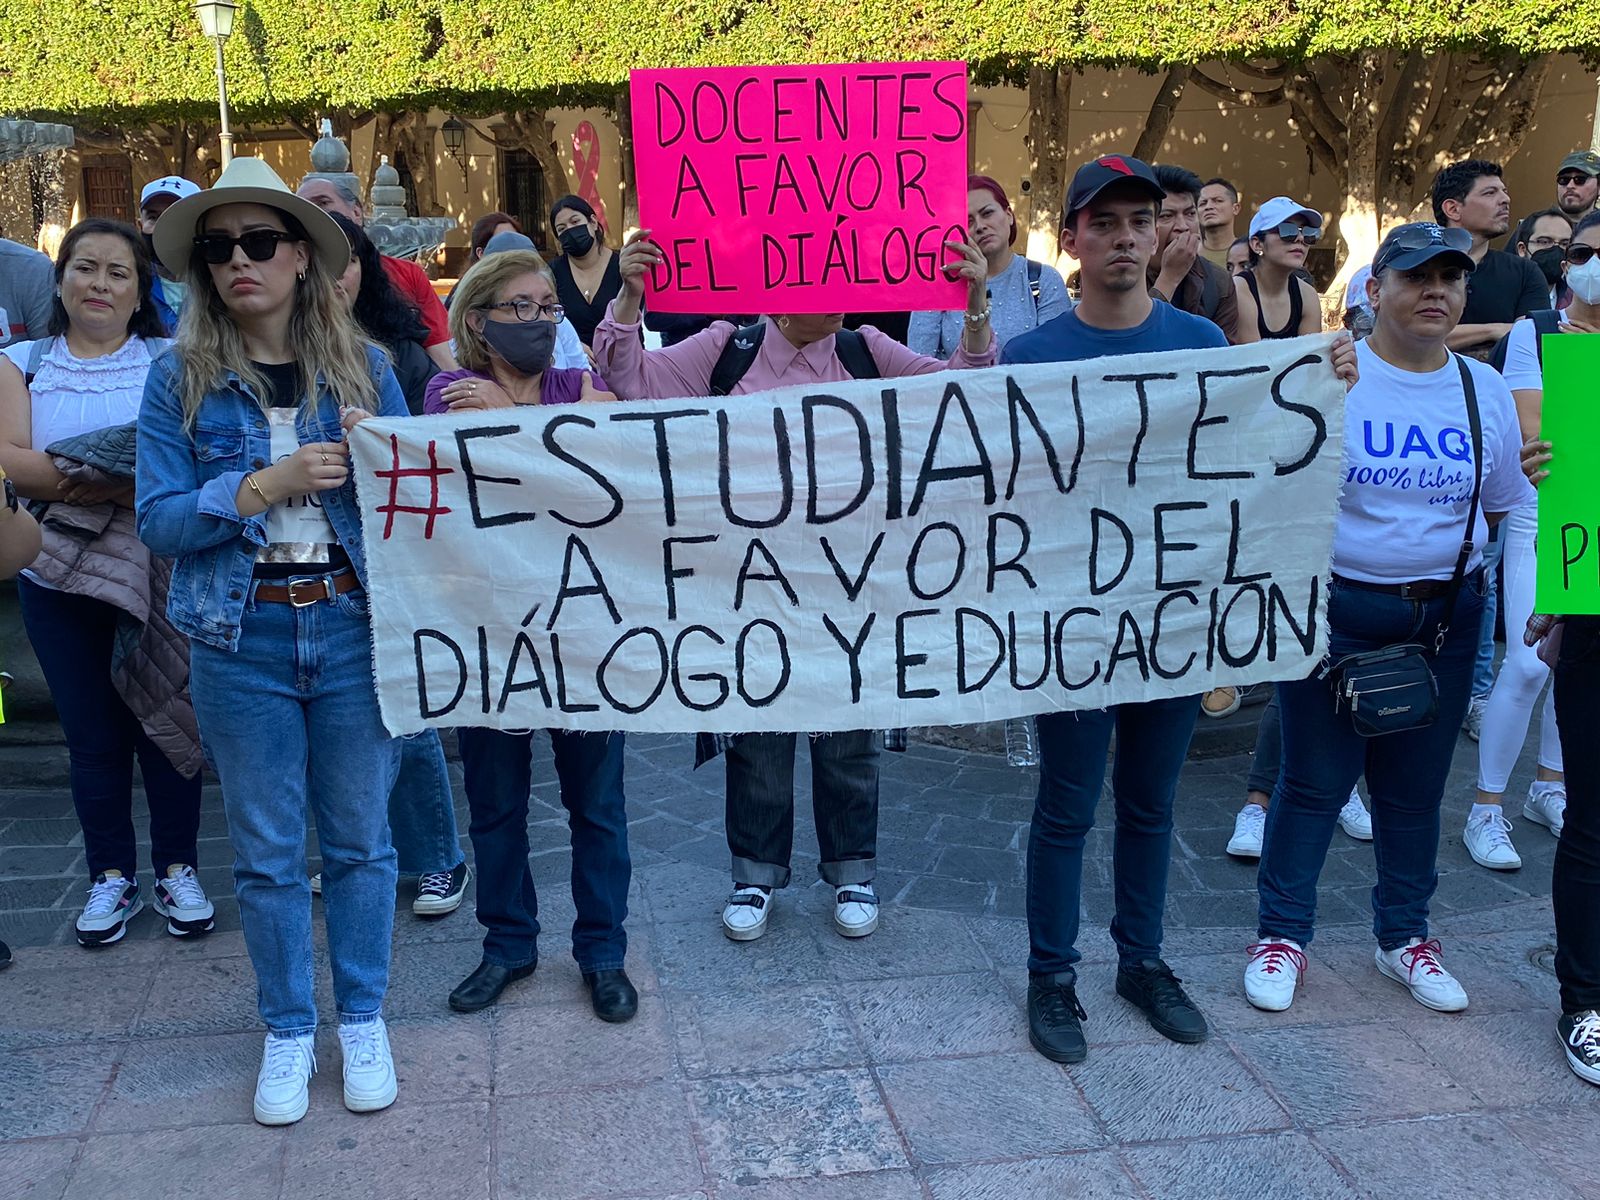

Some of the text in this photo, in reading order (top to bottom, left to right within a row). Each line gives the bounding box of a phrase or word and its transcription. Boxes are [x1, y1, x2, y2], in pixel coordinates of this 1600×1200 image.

[654, 72, 966, 148] DOCENTES
[671, 149, 936, 219] A FAVOR
[648, 214, 969, 292] DEL DIÁLOGO
[374, 354, 1327, 540] #ESTUDIANTES
[1346, 466, 1412, 490] 100%
[1418, 465, 1463, 489] libre
[1363, 419, 1473, 464] UAQ
[546, 499, 1272, 631] A FAVOR DEL
[413, 603, 791, 719] DIÁLOGO
